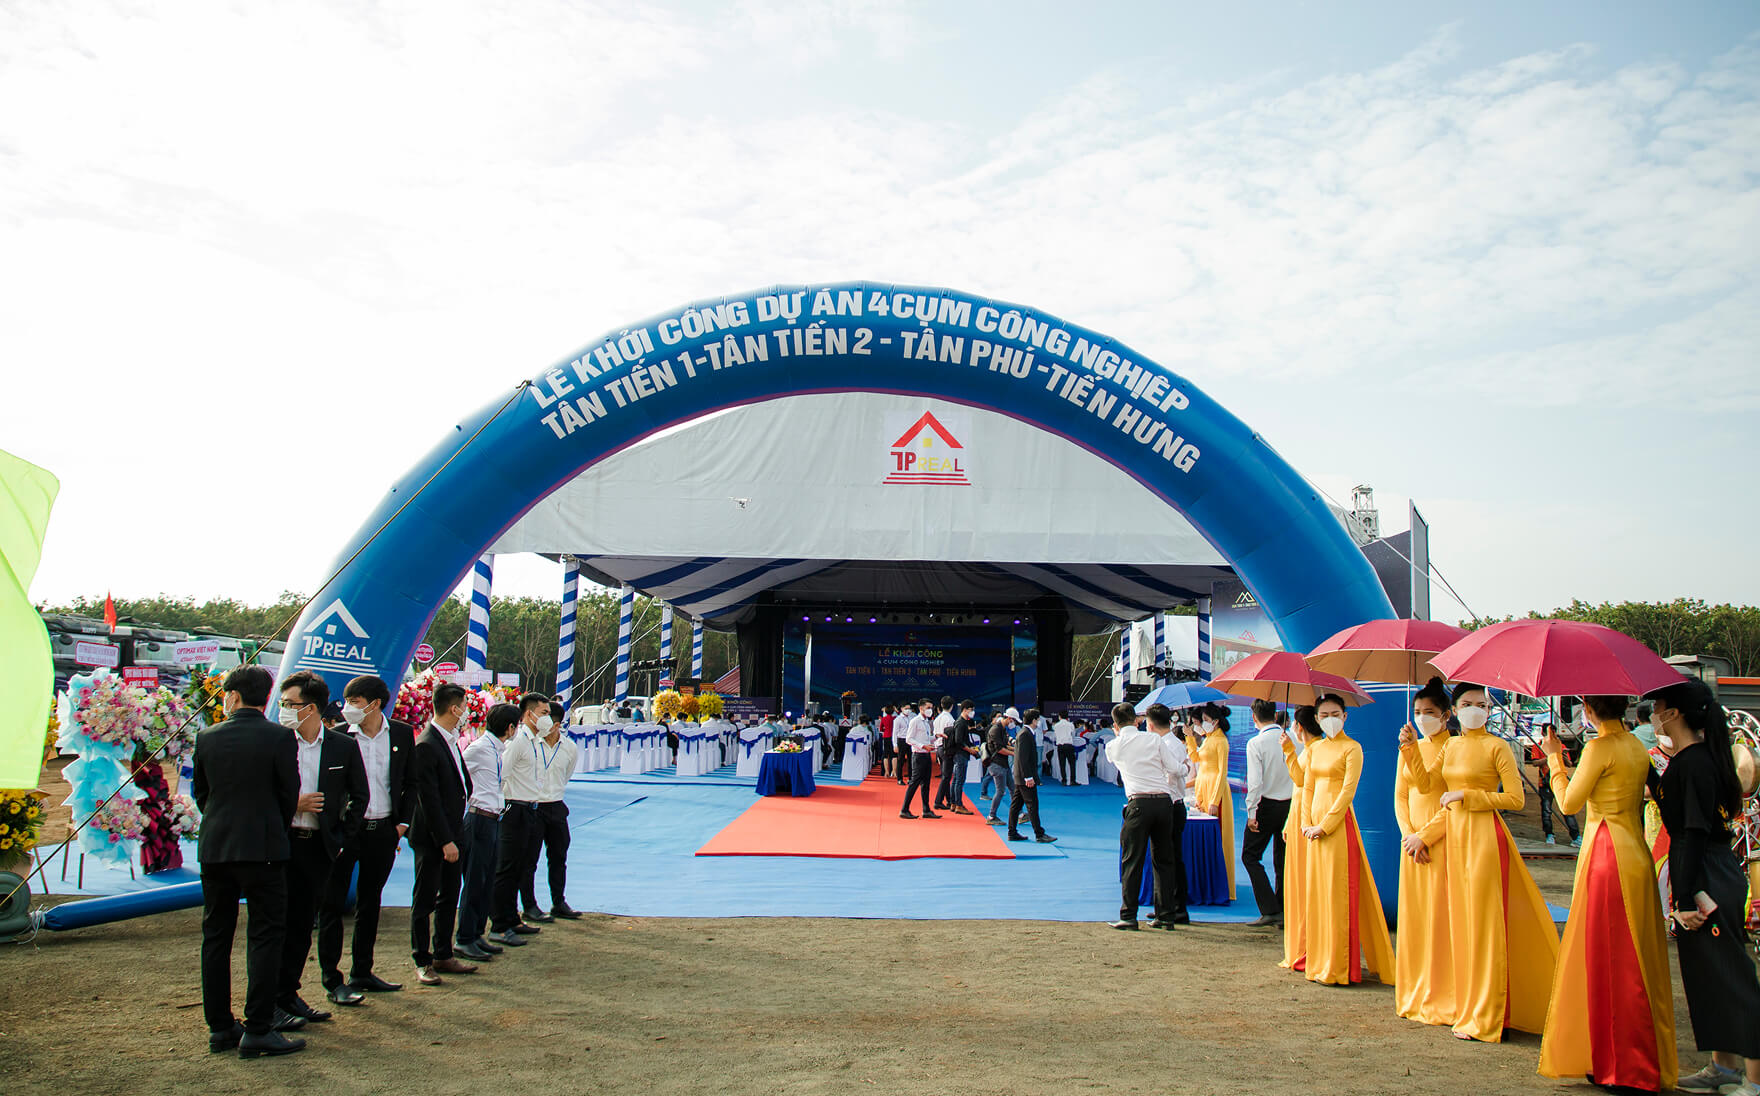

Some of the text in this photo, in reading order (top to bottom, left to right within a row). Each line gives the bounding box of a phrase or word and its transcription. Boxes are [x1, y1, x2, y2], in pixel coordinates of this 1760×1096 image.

[541, 400, 608, 440] TÂN
[604, 358, 679, 408] TIẾN
[773, 320, 848, 358] TIẾN
[852, 328, 873, 355] 2
[901, 328, 964, 364] TÂN
[969, 347, 1034, 379] PHÚ
[1112, 402, 1201, 474] HƯNG
[571, 328, 654, 384] KHỞI
[657, 301, 750, 345] CÔNG
[756, 291, 806, 325] DỰ
[811, 288, 863, 316] ÁN
[975, 310, 1071, 357] CÔNG
[1069, 337, 1190, 413] NGHIỆP
[917, 649, 943, 658] CÔNG
